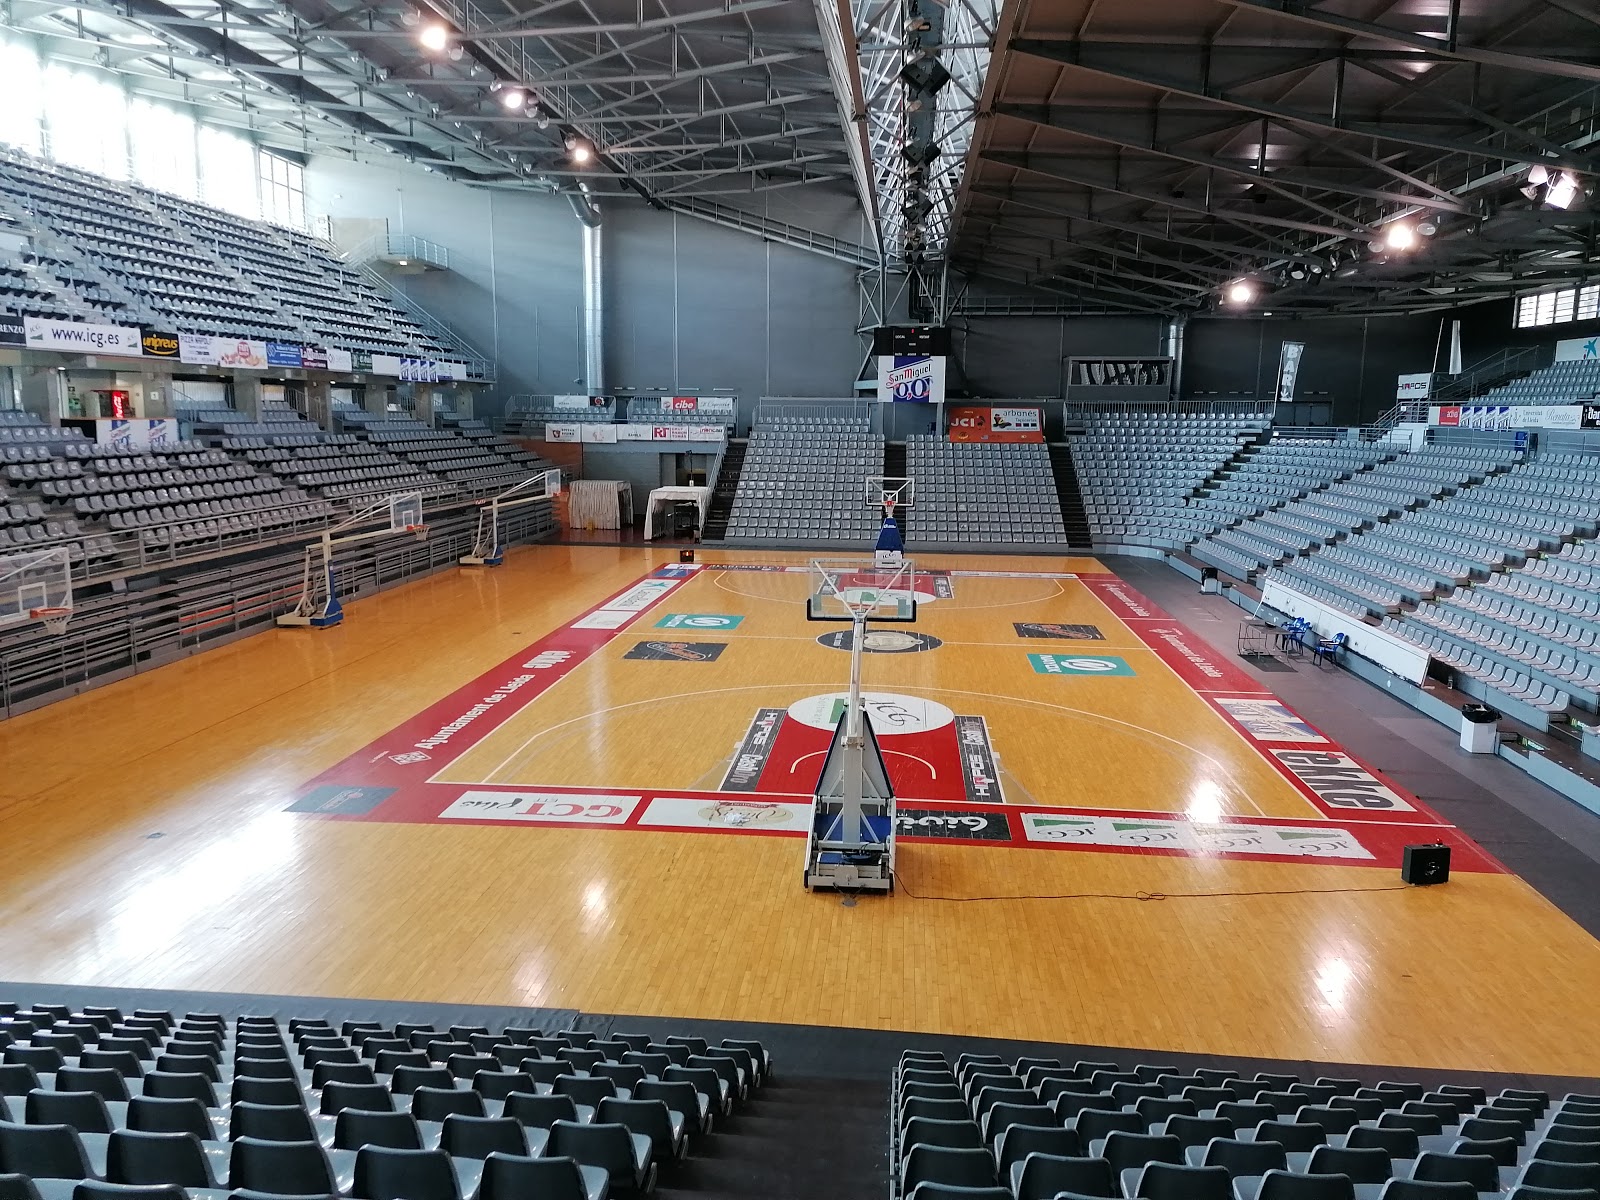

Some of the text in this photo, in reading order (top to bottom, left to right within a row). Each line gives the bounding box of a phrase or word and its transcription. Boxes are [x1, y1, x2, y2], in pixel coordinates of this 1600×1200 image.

[51, 328, 120, 348] www.icg.es
[142, 334, 178, 350] unipreus
[1282, 346, 1299, 386] BAR
[951, 418, 975, 427] JCI
[414, 674, 536, 749] Ajuntament de Lleida
[515, 803, 623, 818] GCT
[1037, 827, 1096, 839] ICG
[1119, 832, 1178, 843] ICG
[1288, 840, 1348, 853] ICG
